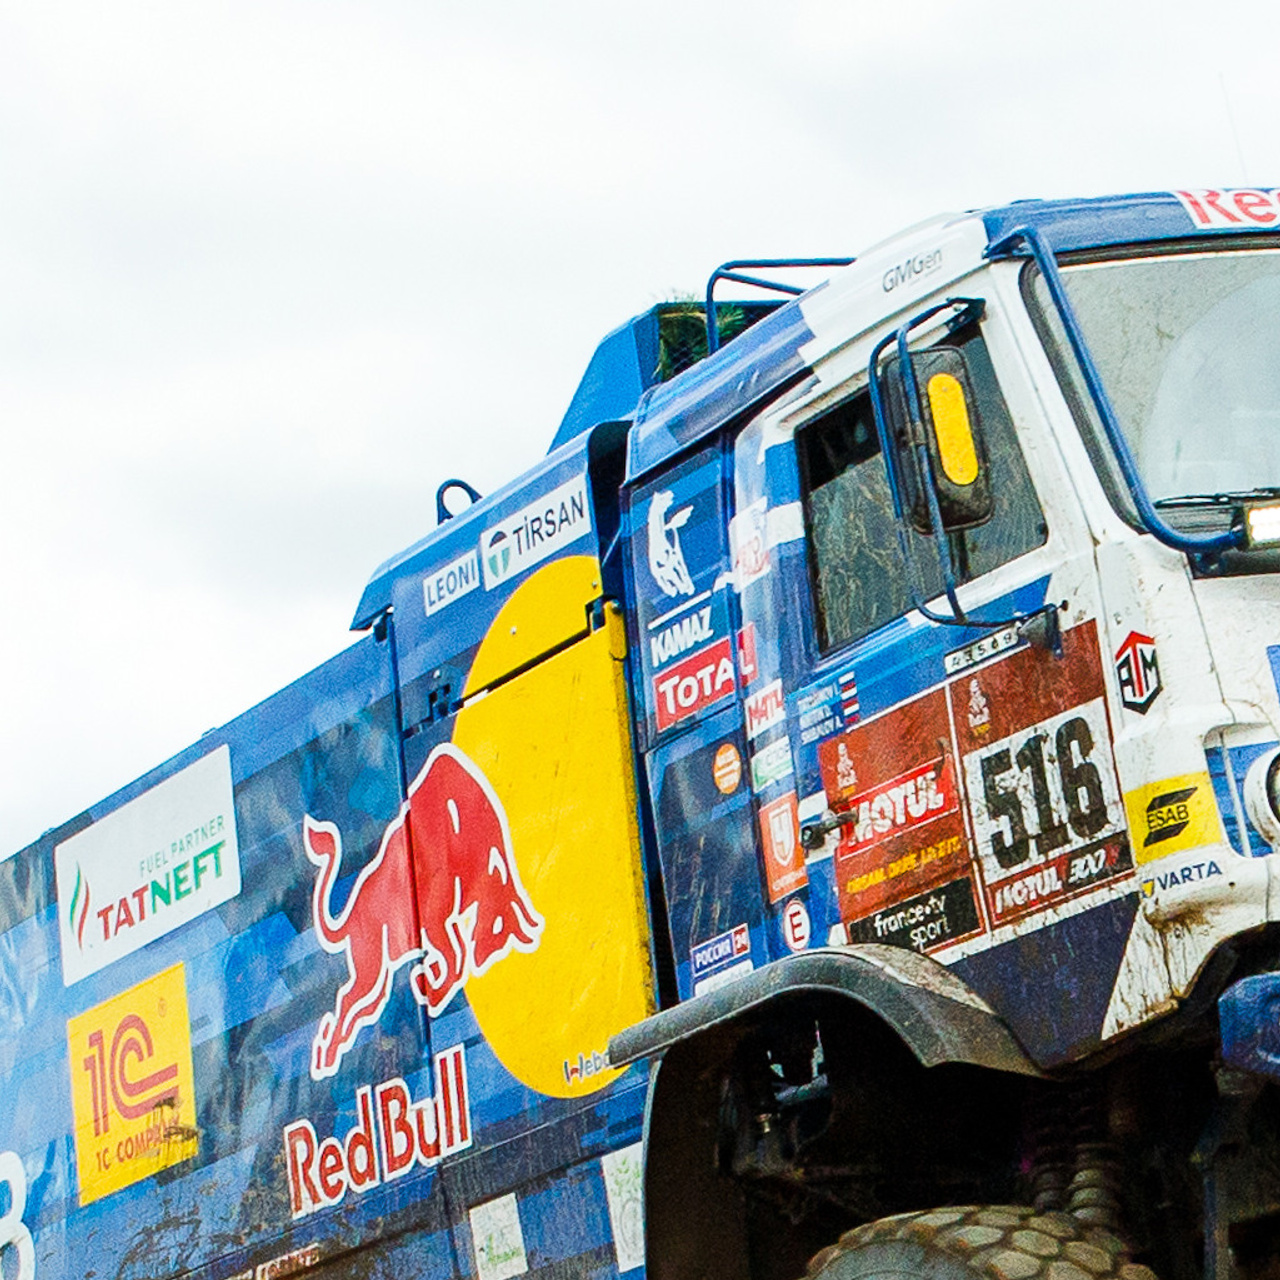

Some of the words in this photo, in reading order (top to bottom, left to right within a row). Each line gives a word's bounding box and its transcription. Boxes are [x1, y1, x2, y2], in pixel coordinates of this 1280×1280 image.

[427, 558, 476, 608] LEONI
[651, 606, 714, 668] KAMAZ
[658, 648, 755, 715] TOTAL
[848, 770, 945, 847] MOTUL
[980, 716, 1110, 869] 516
[1147, 804, 1190, 829] ESAB
[139, 851, 169, 878] FUEL
[171, 815, 226, 858] PARTNER
[1157, 860, 1222, 892] VARTA
[97, 839, 227, 941] TATNEFT
[910, 914, 951, 954] sport
